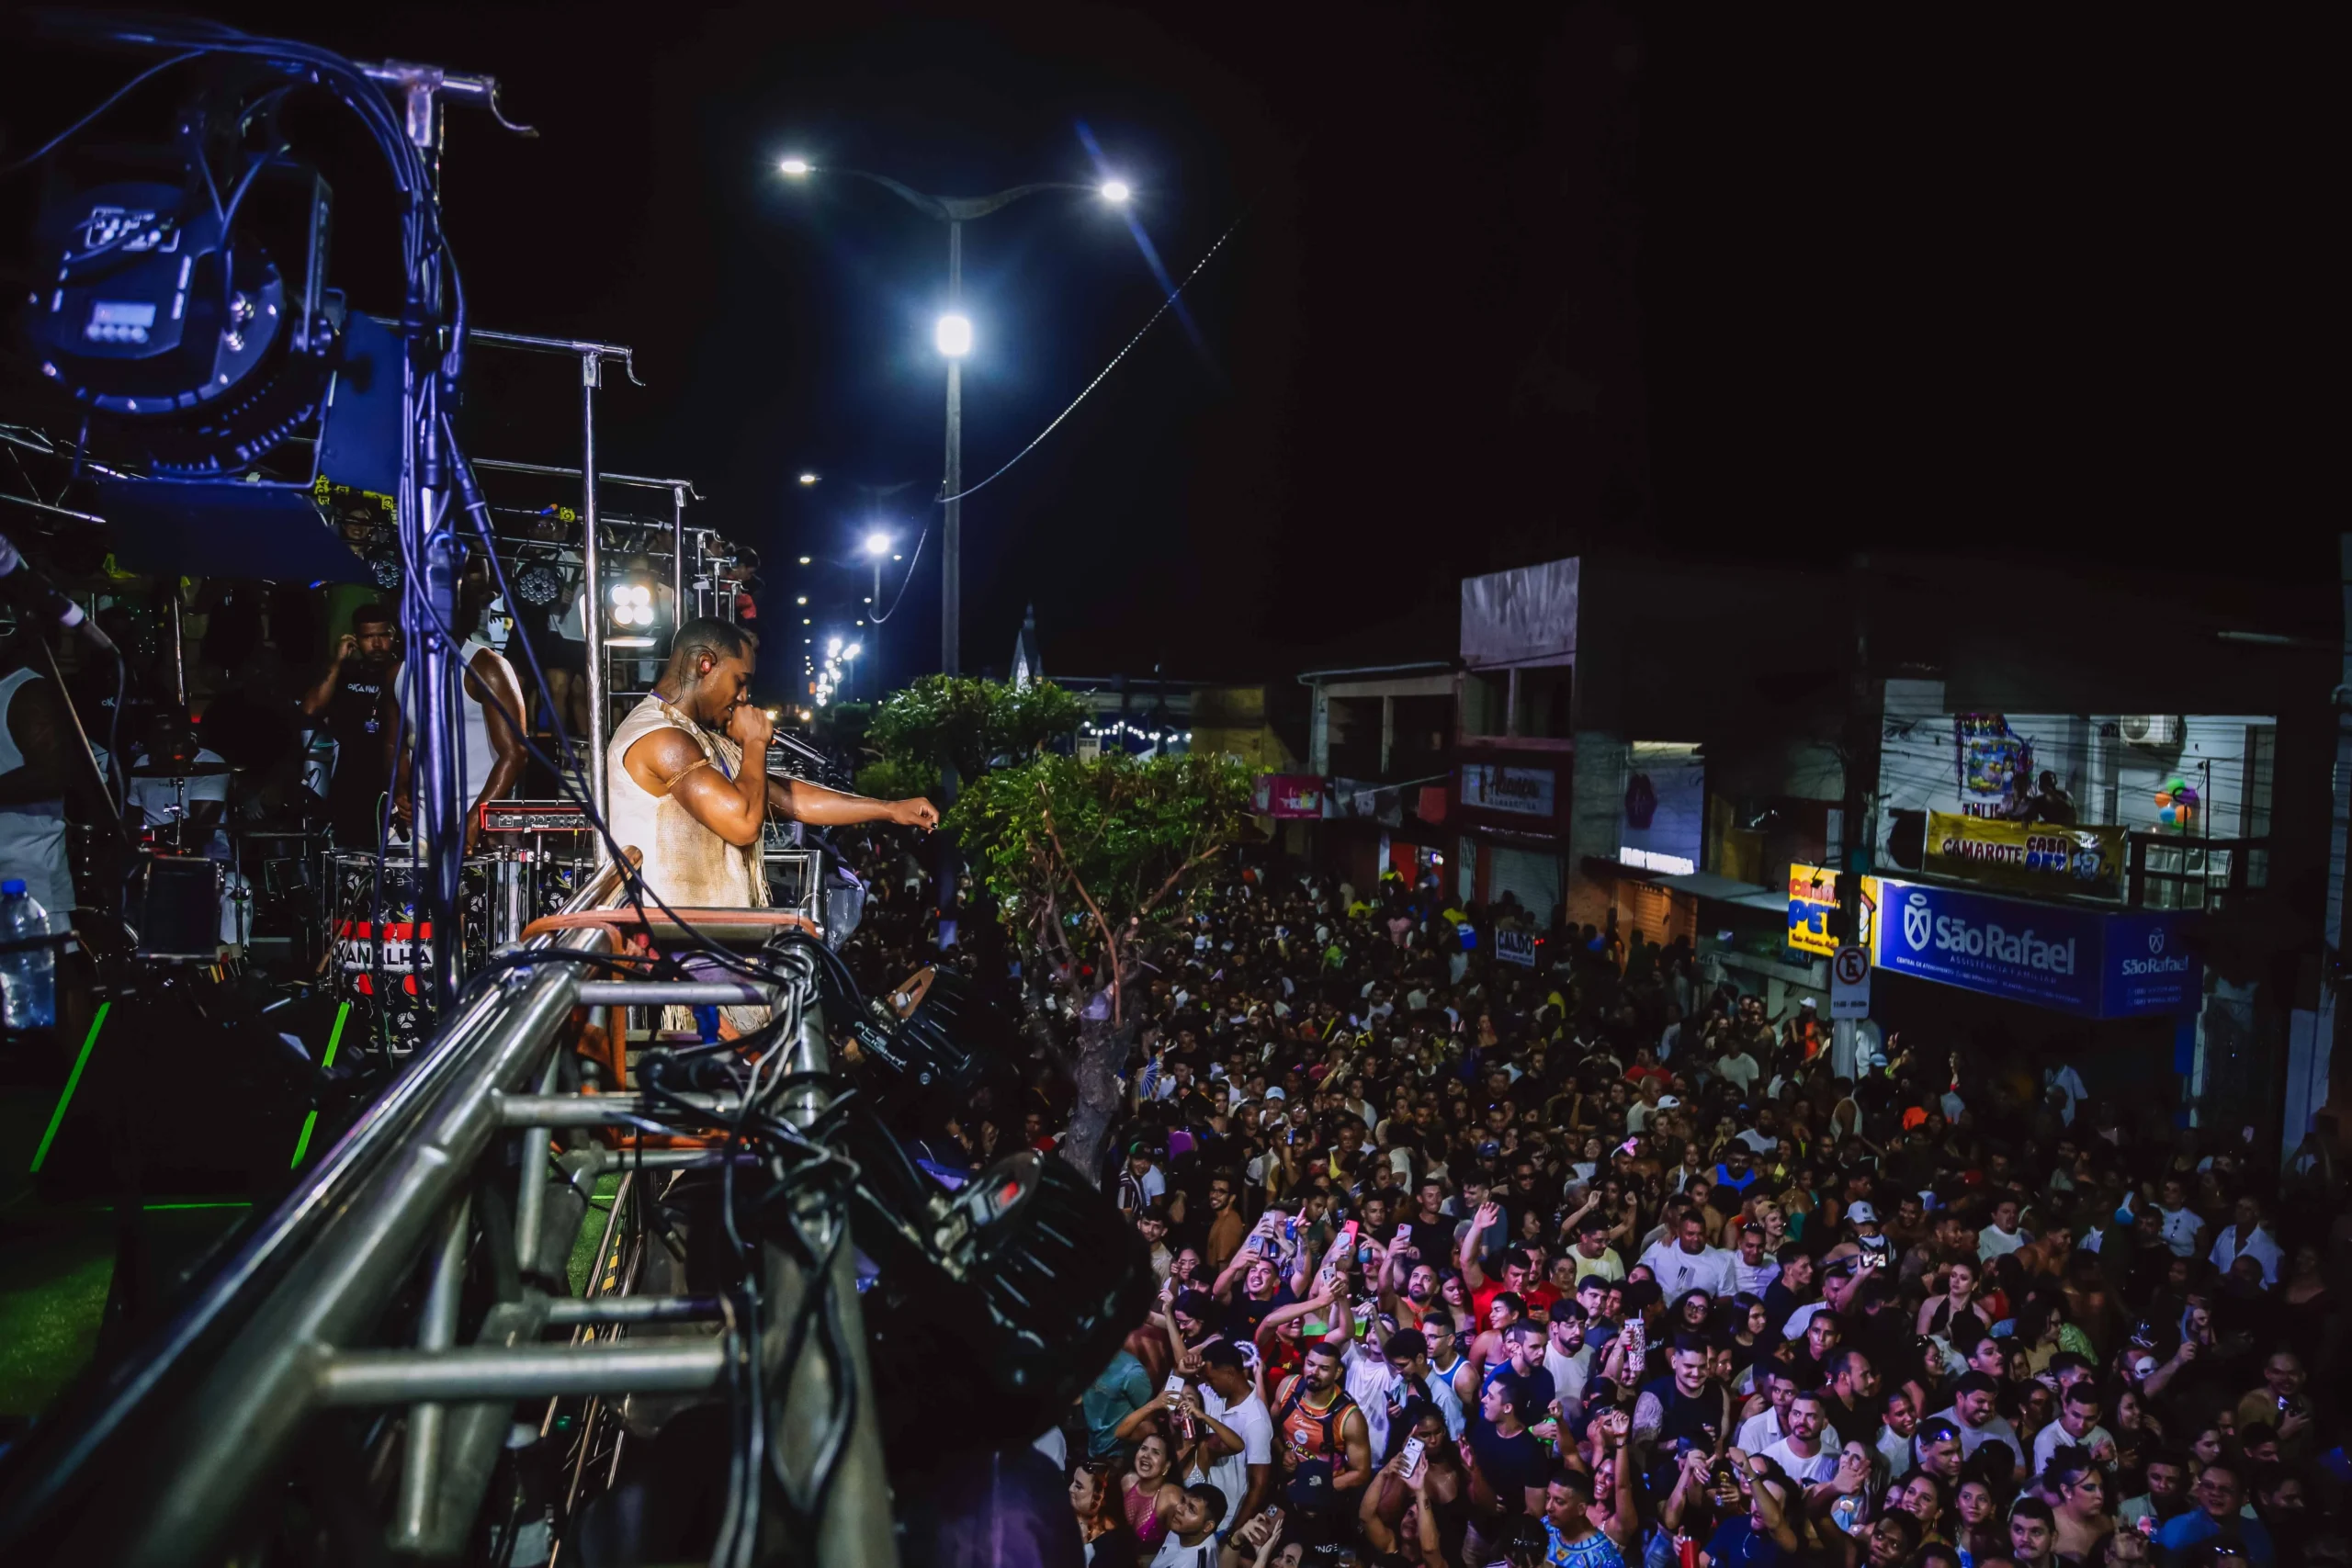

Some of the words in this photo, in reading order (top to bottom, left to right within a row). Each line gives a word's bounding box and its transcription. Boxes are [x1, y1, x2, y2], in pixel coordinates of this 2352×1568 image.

[1942, 838, 2023, 864] CAMAROTE
[2025, 836, 2068, 853] CASA
[1498, 931, 1533, 956] CALDO
